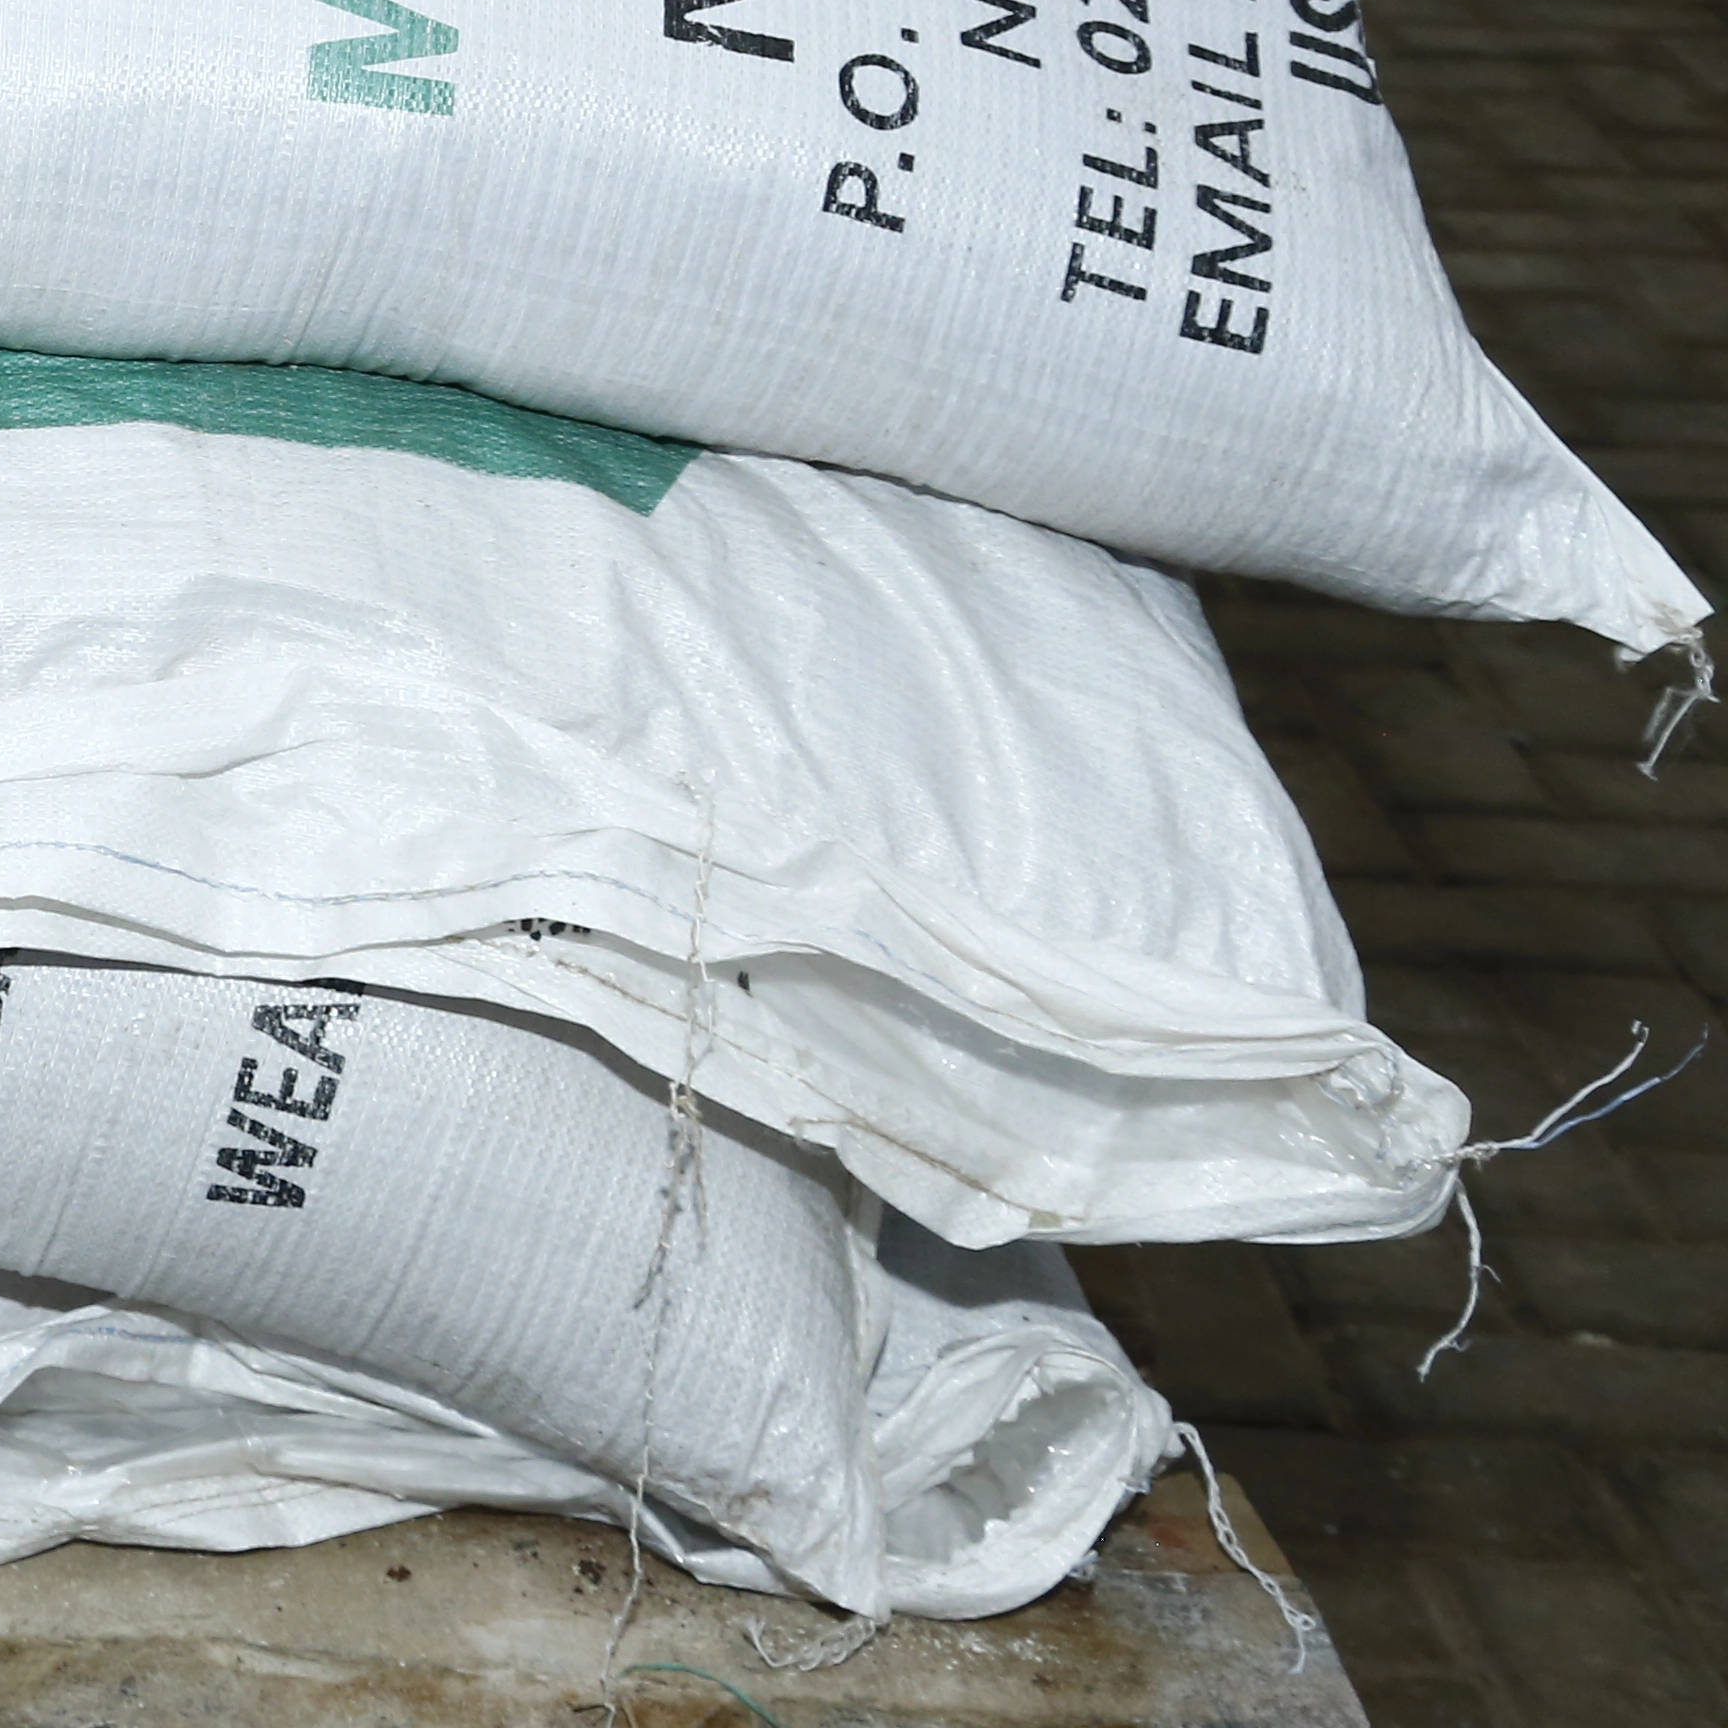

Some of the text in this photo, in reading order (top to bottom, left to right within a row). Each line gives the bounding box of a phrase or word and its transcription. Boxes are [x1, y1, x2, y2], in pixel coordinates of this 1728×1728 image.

[822, 26, 919, 234] P.O.
[1060, 105, 1161, 304] TEL:
[1178, 31, 1275, 356] EMAIL
[204, 1000, 363, 1209] WEA
